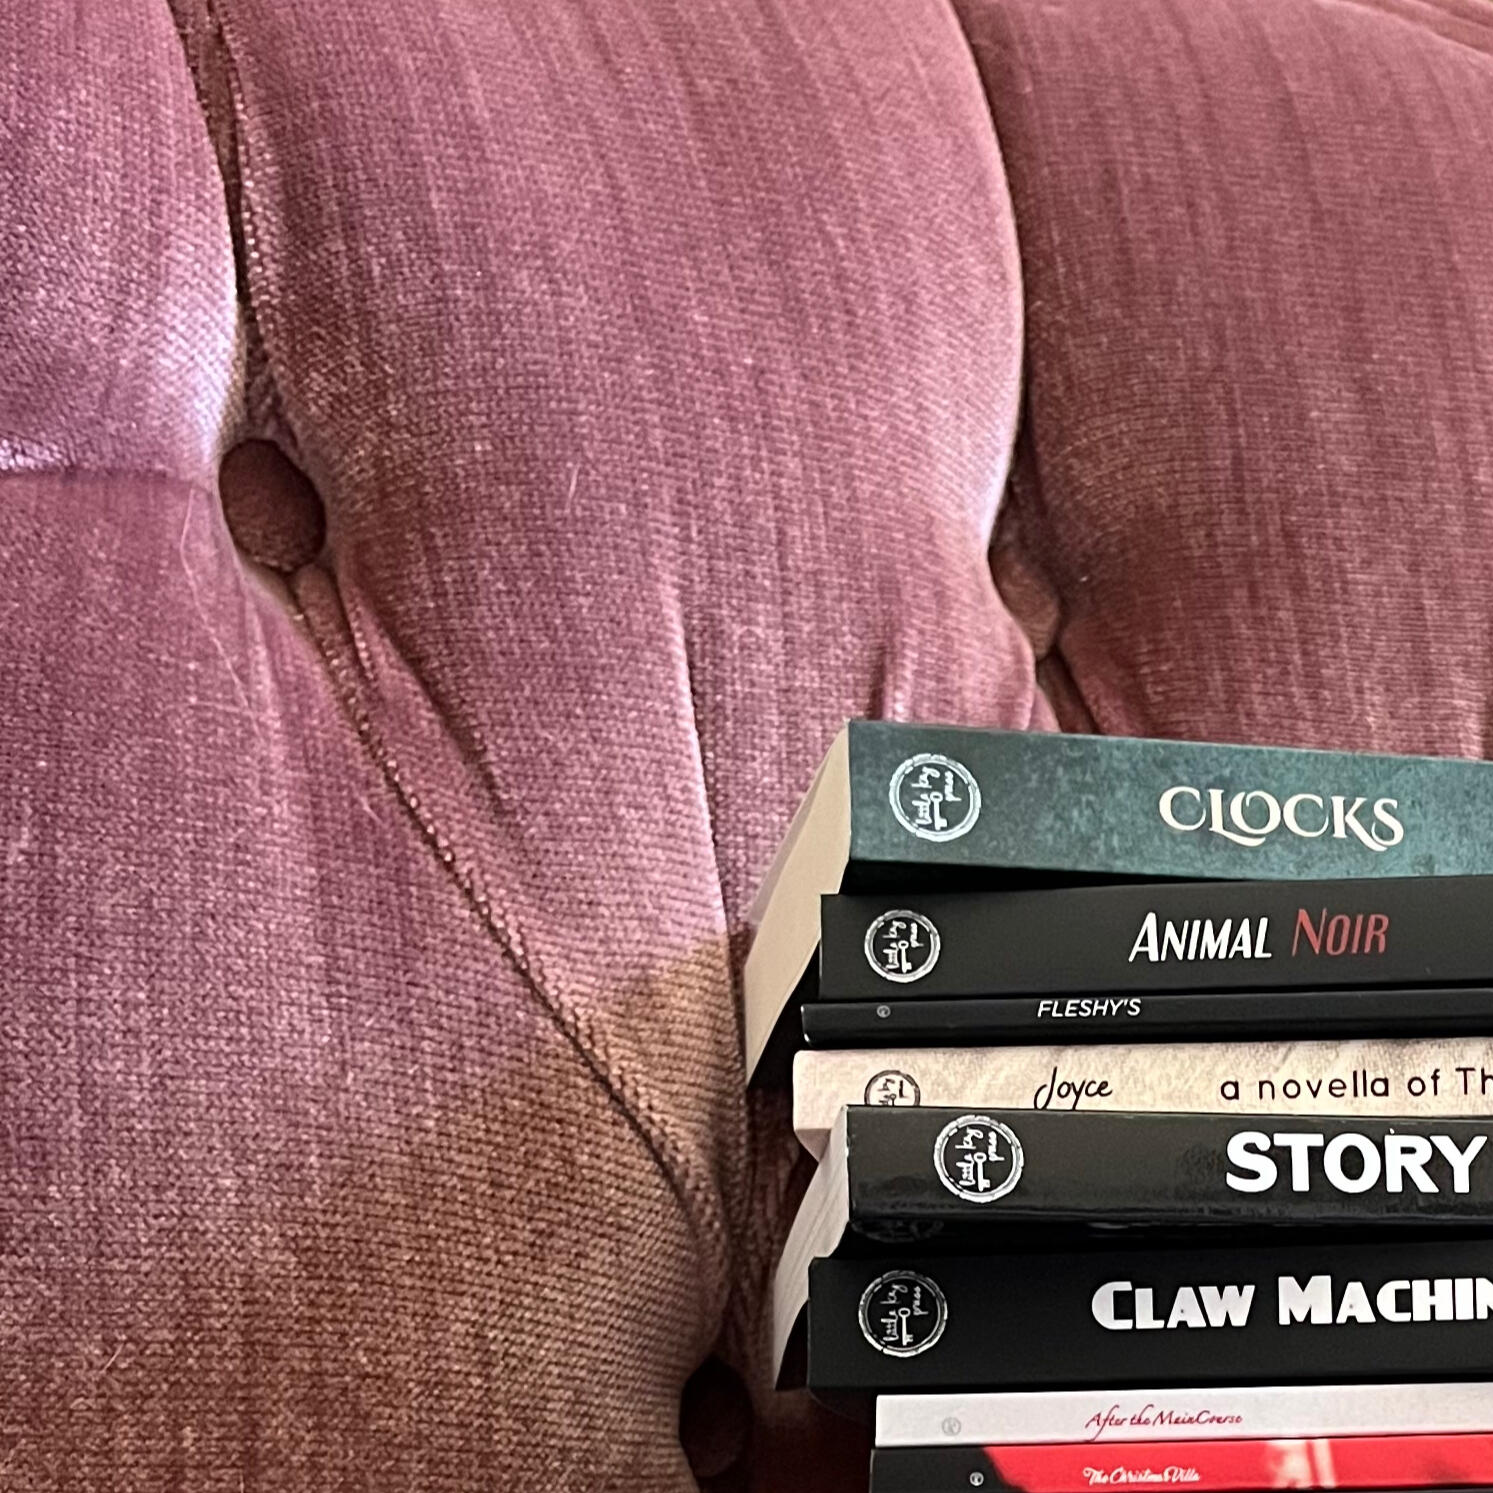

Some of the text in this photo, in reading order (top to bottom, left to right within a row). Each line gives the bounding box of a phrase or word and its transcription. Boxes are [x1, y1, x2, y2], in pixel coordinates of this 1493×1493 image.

[911, 767, 939, 788] key
[1158, 786, 1405, 851] CLOCKS
[884, 920, 906, 939] key
[1128, 908, 1389, 963] ANIMAL NOIR
[1037, 998, 1142, 1018] FLESHY'S
[1034, 1066, 1113, 1110] Joyce
[1220, 1080, 1240, 1102] a
[1257, 1071, 1390, 1101] novella
[1408, 1070, 1442, 1097] of
[956, 1128, 982, 1149] key
[1225, 1130, 1487, 1194] STORY
[880, 1284, 907, 1304] key
[1090, 1279, 1253, 1331] CLAW
[1085, 1405, 1127, 1442] After
